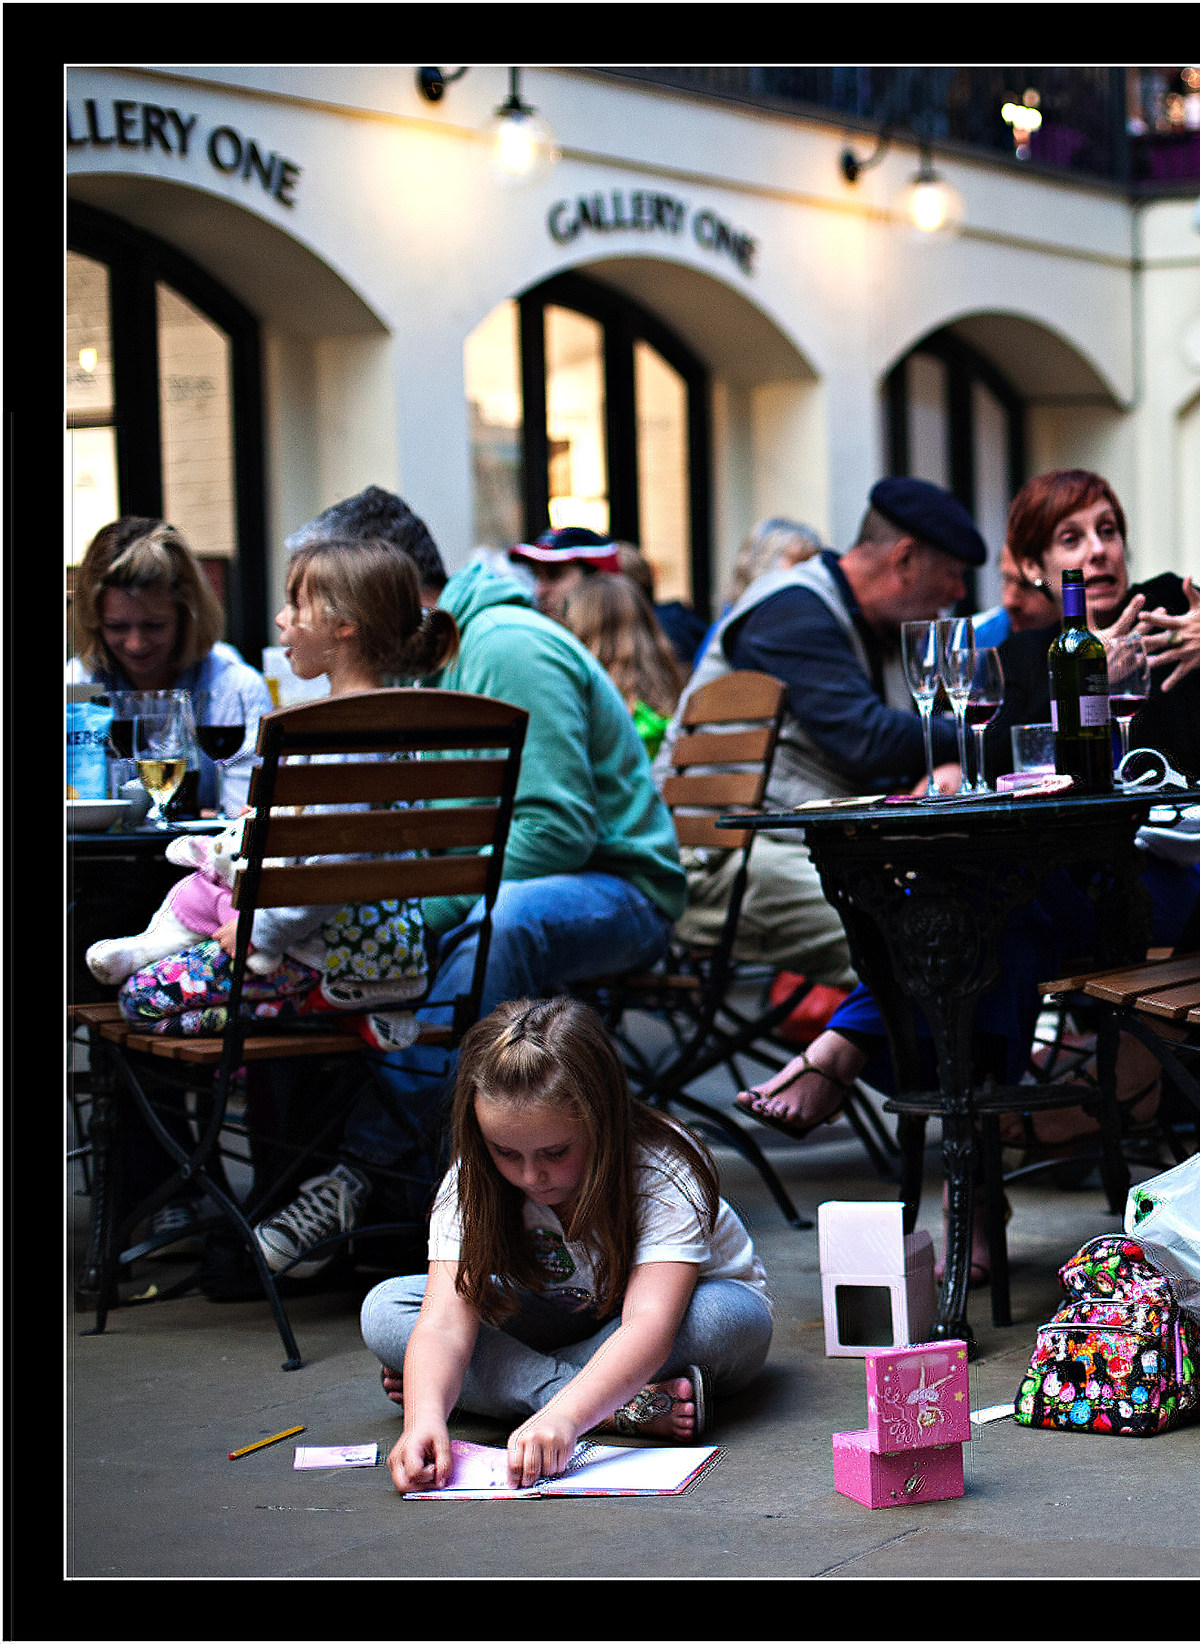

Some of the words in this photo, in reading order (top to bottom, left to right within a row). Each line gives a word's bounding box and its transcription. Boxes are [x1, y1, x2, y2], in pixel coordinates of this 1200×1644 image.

[206, 124, 302, 207] ONE
[547, 189, 687, 247] GALLERY
[693, 207, 759, 277] ONE
